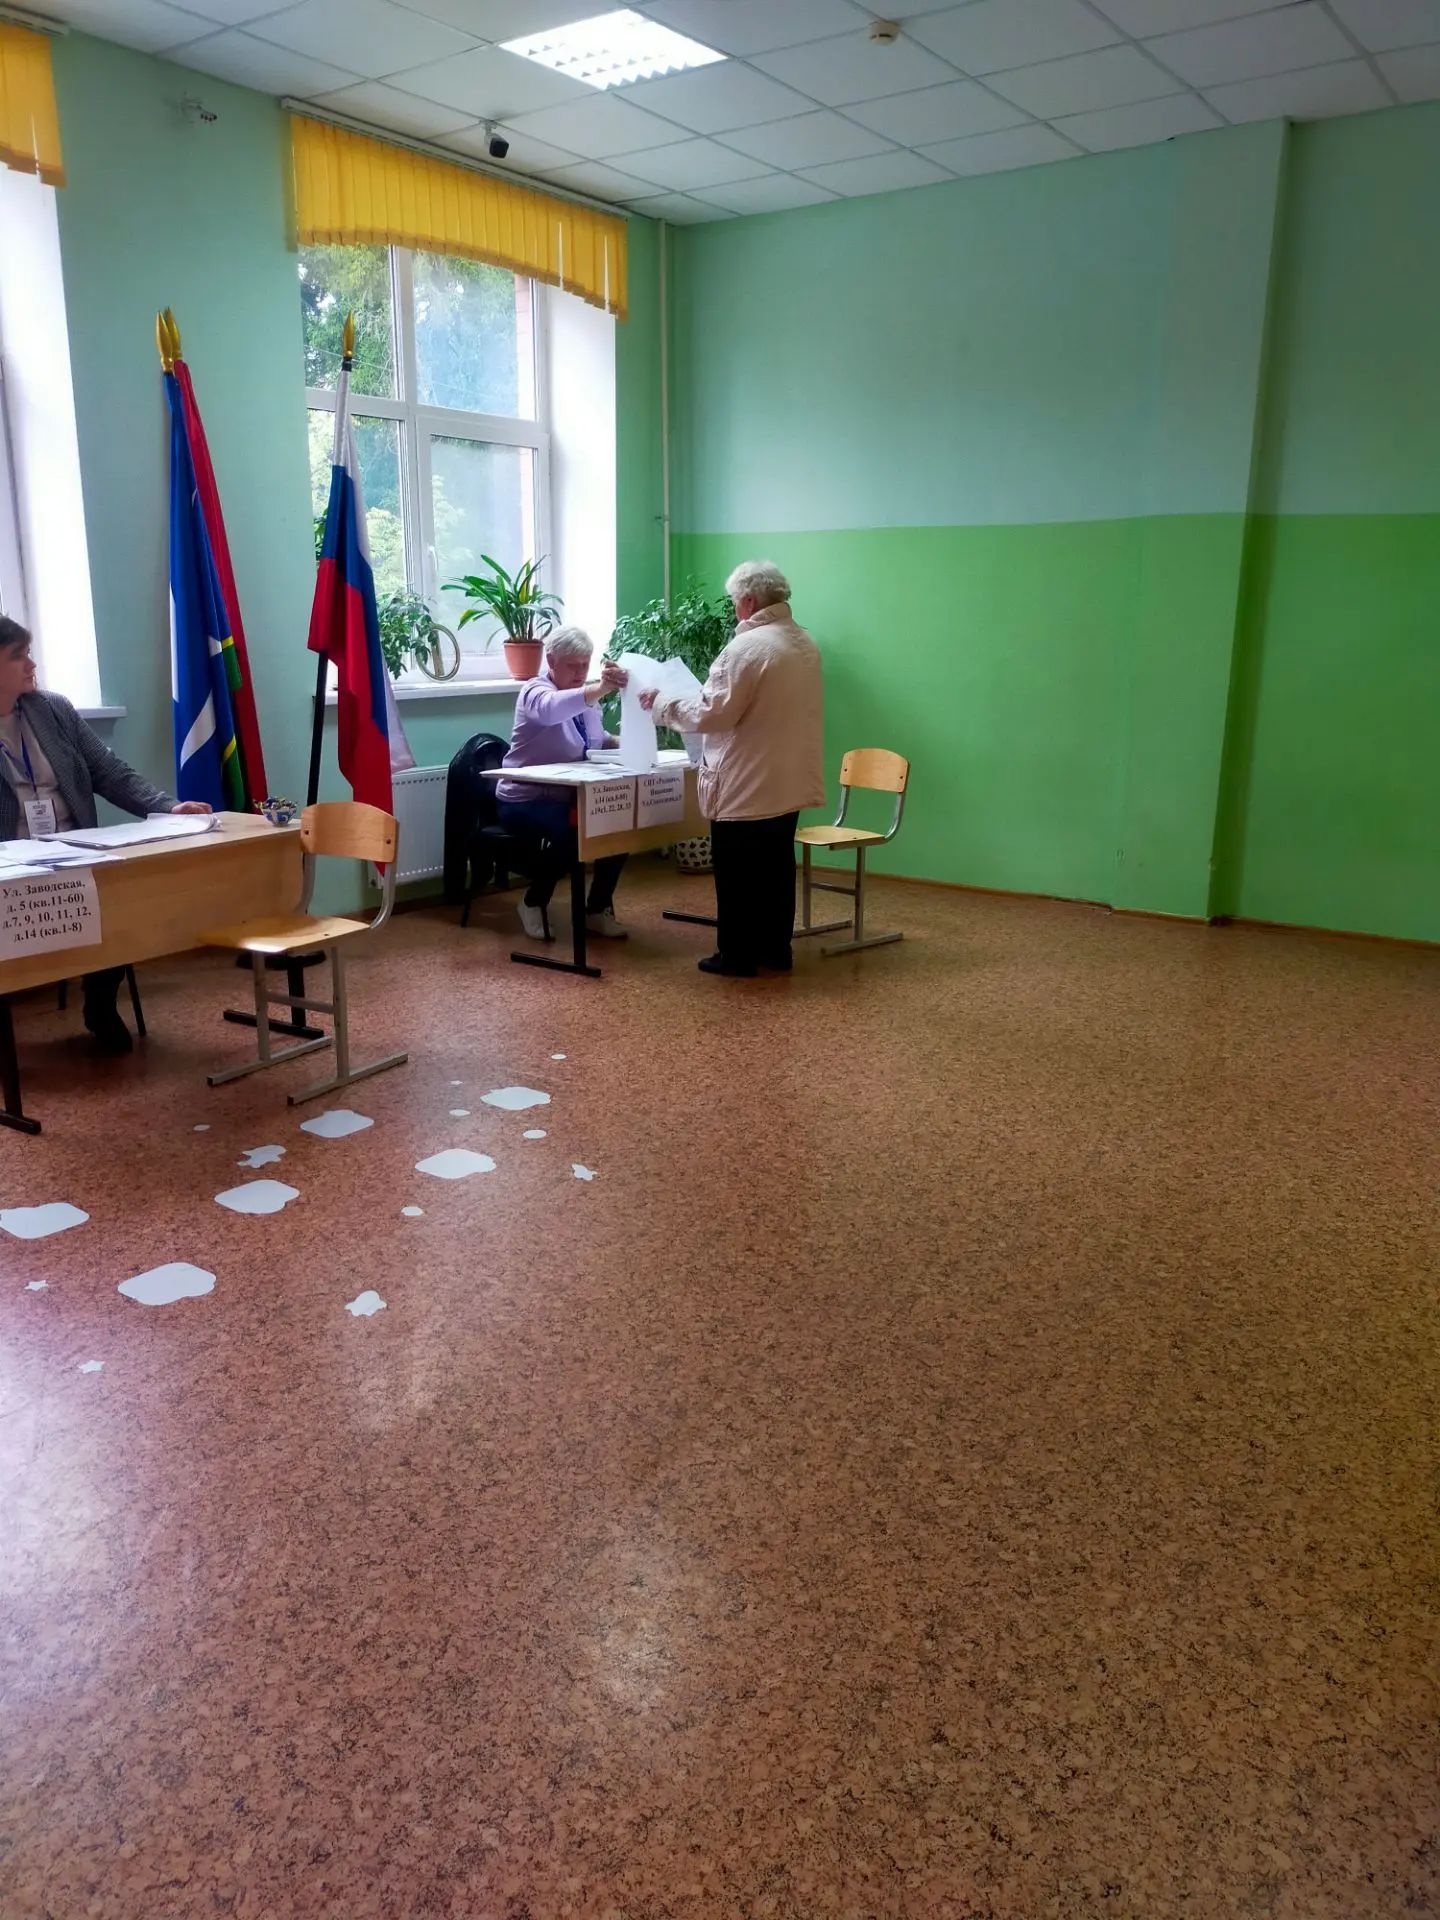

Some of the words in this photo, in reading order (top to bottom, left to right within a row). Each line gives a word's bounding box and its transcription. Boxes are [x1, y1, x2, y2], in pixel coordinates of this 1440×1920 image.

[3, 888, 22, 898] Ул.
[24, 880, 86, 895] Заводская,
[7, 905, 17, 914] д.
[19, 900, 26, 911] 5
[28, 892, 84, 911] (кв.11-60)
[24, 914, 35, 925] 9,
[38, 911, 54, 923] 10,
[57, 909, 73, 920] 11,
[76, 906, 92, 917] 12,
[14, 928, 37, 942] д.14
[40, 922, 82, 939] (кв.1-8)
